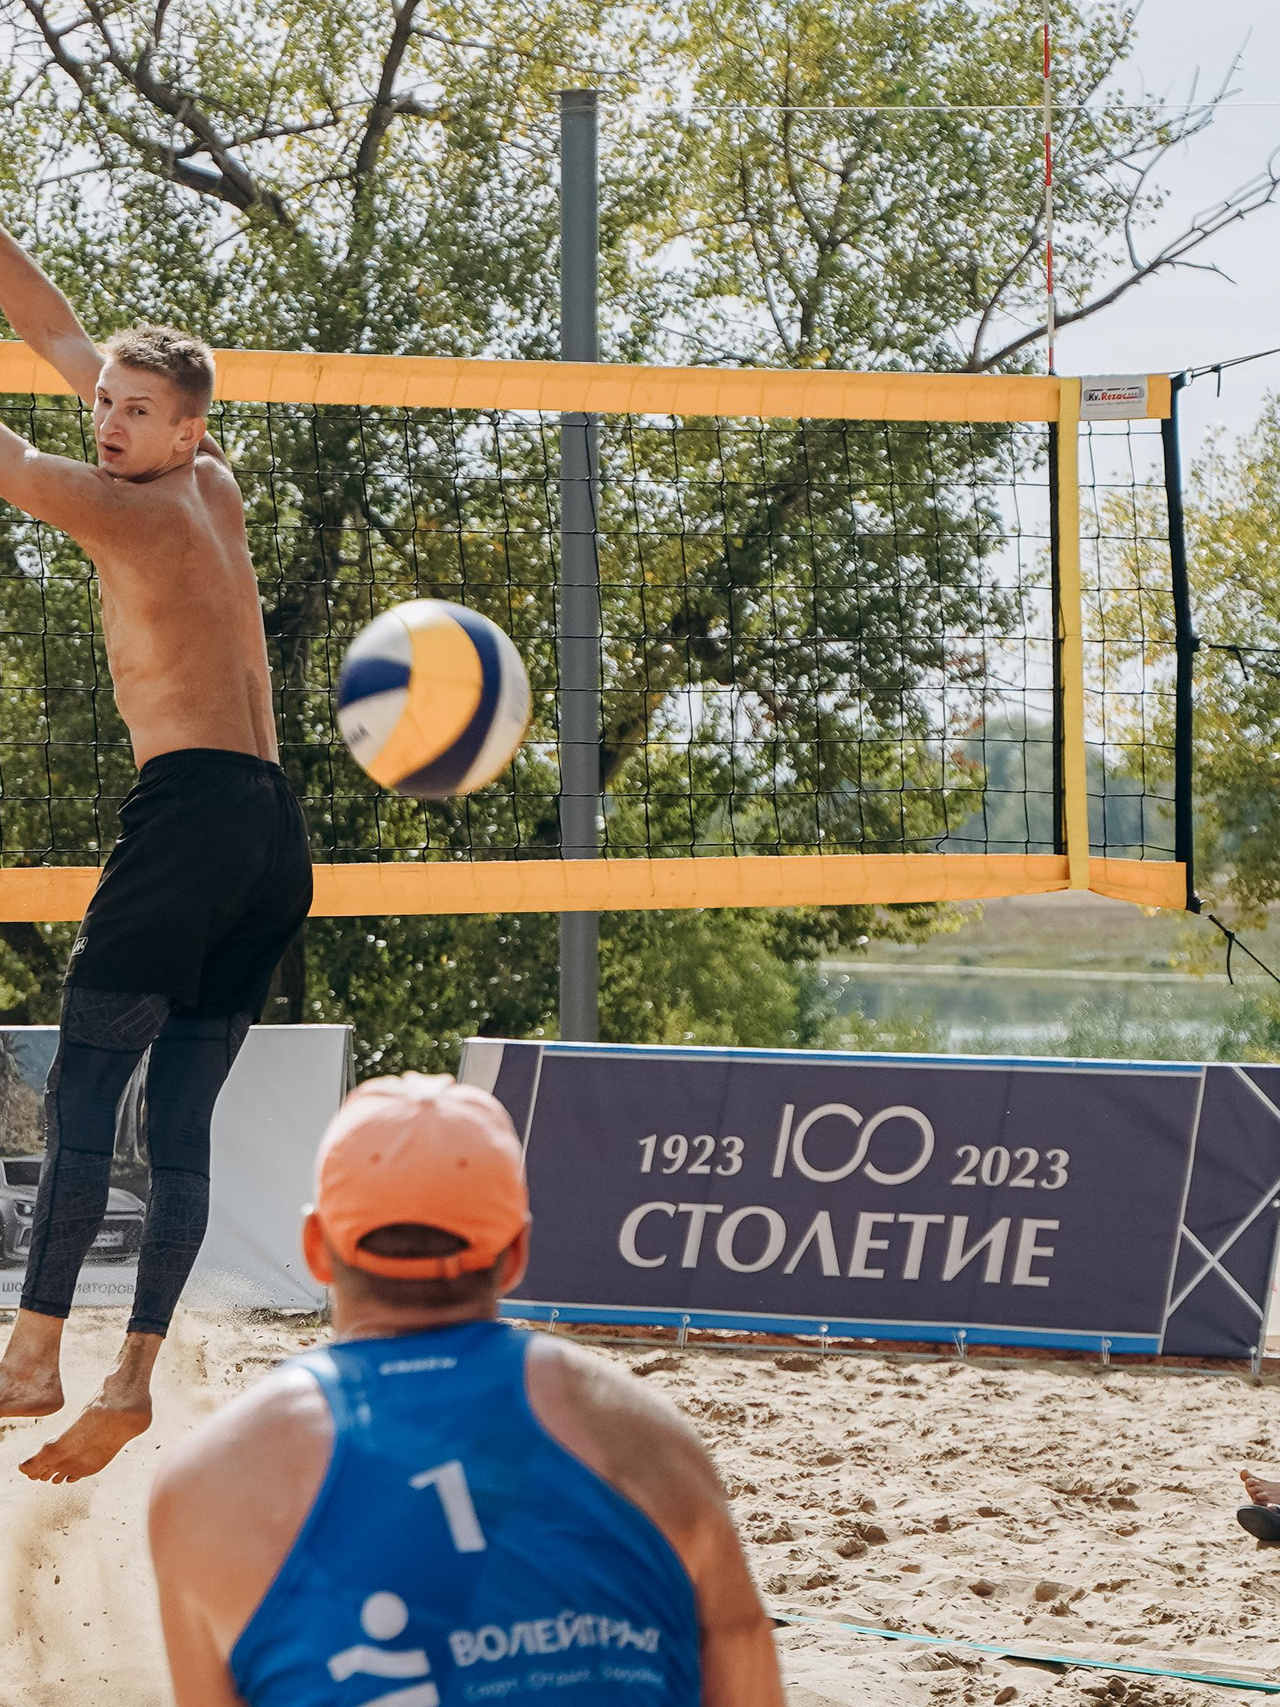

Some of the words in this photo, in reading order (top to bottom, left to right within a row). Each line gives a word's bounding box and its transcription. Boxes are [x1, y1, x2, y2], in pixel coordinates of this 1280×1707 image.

[638, 1133, 746, 1177] 1923
[951, 1143, 1070, 1190] 2023
[619, 1201, 1061, 1287] СТОЛЕТИЕ
[2, 1281, 23, 1293] шо
[77, 1282, 135, 1295] иаторов
[408, 1459, 487, 1554] 1
